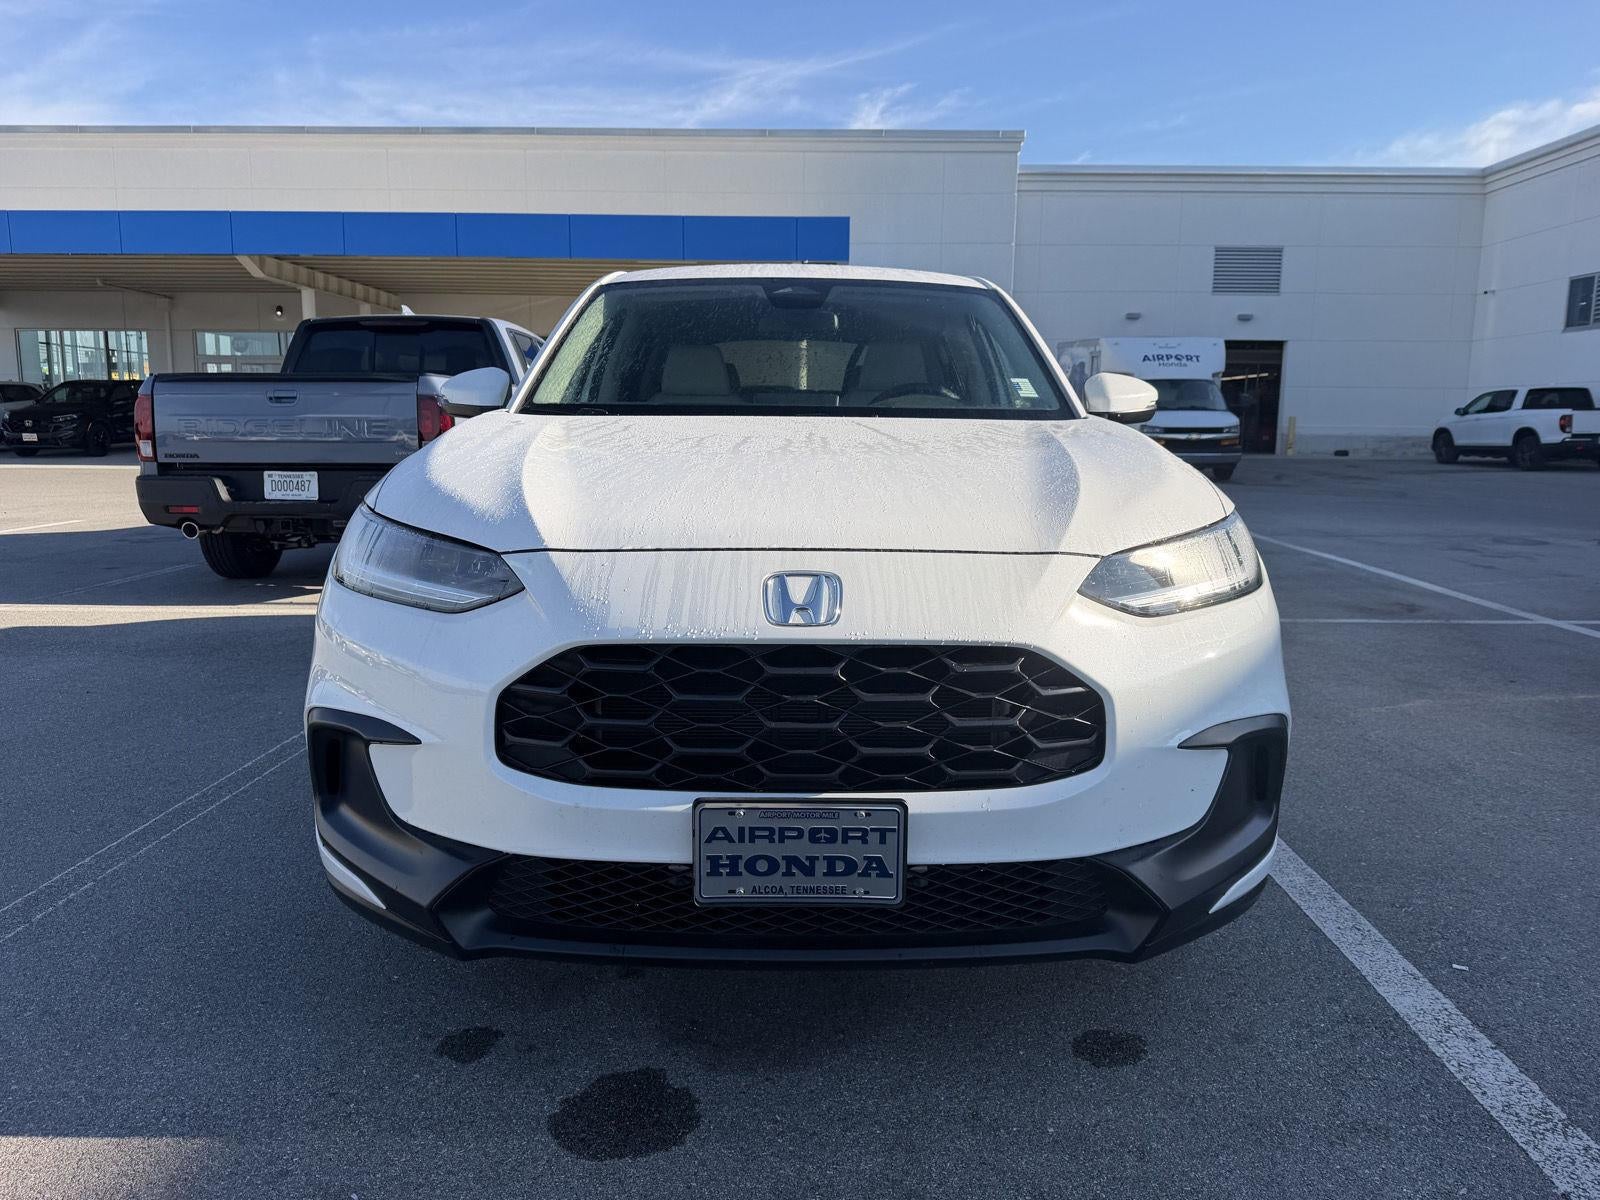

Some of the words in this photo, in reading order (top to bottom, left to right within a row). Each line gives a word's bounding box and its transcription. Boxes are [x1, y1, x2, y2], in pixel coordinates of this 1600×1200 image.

[1142, 354, 1200, 362] AIRPORT
[759, 810, 791, 819] AIRPORT
[704, 826, 897, 844] AIRPORT
[706, 854, 894, 878] HONDA
[751, 885, 787, 895] ALCOA,
[790, 885, 847, 895] TENNESSEE
